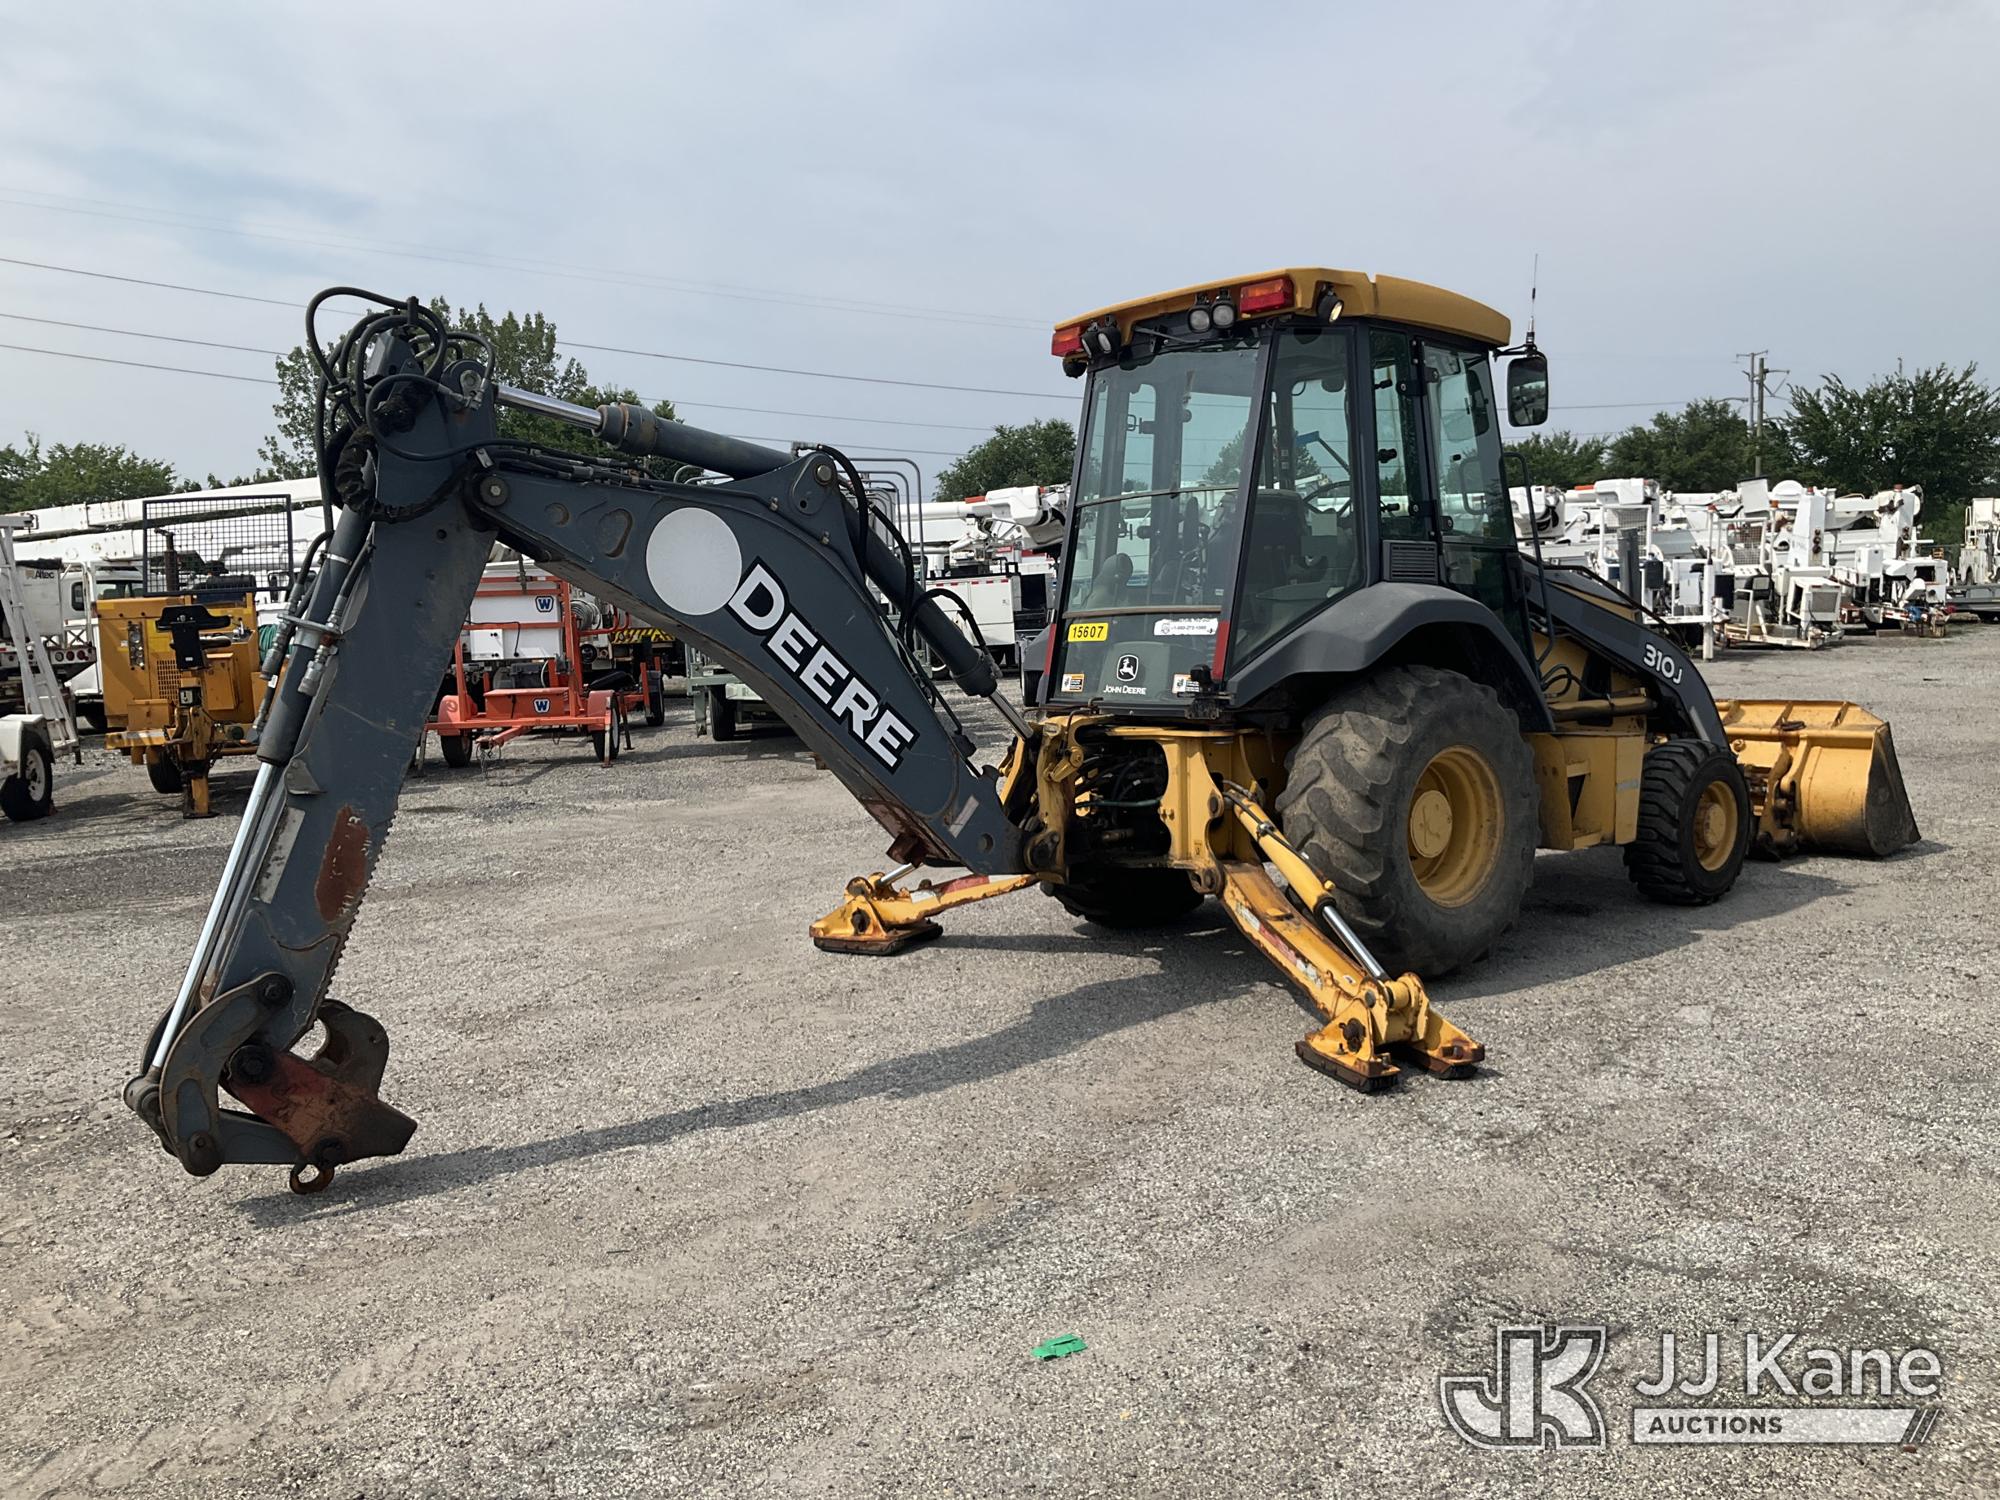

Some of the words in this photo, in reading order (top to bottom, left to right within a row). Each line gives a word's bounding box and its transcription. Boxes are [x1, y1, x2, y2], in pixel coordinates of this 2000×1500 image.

[1073, 626, 1104, 638] 15607
[728, 563, 914, 767] DEERE
[1643, 644, 1682, 684] 310J
[1103, 684, 1122, 693] JOHN
[1122, 685, 1147, 695] DEERE
